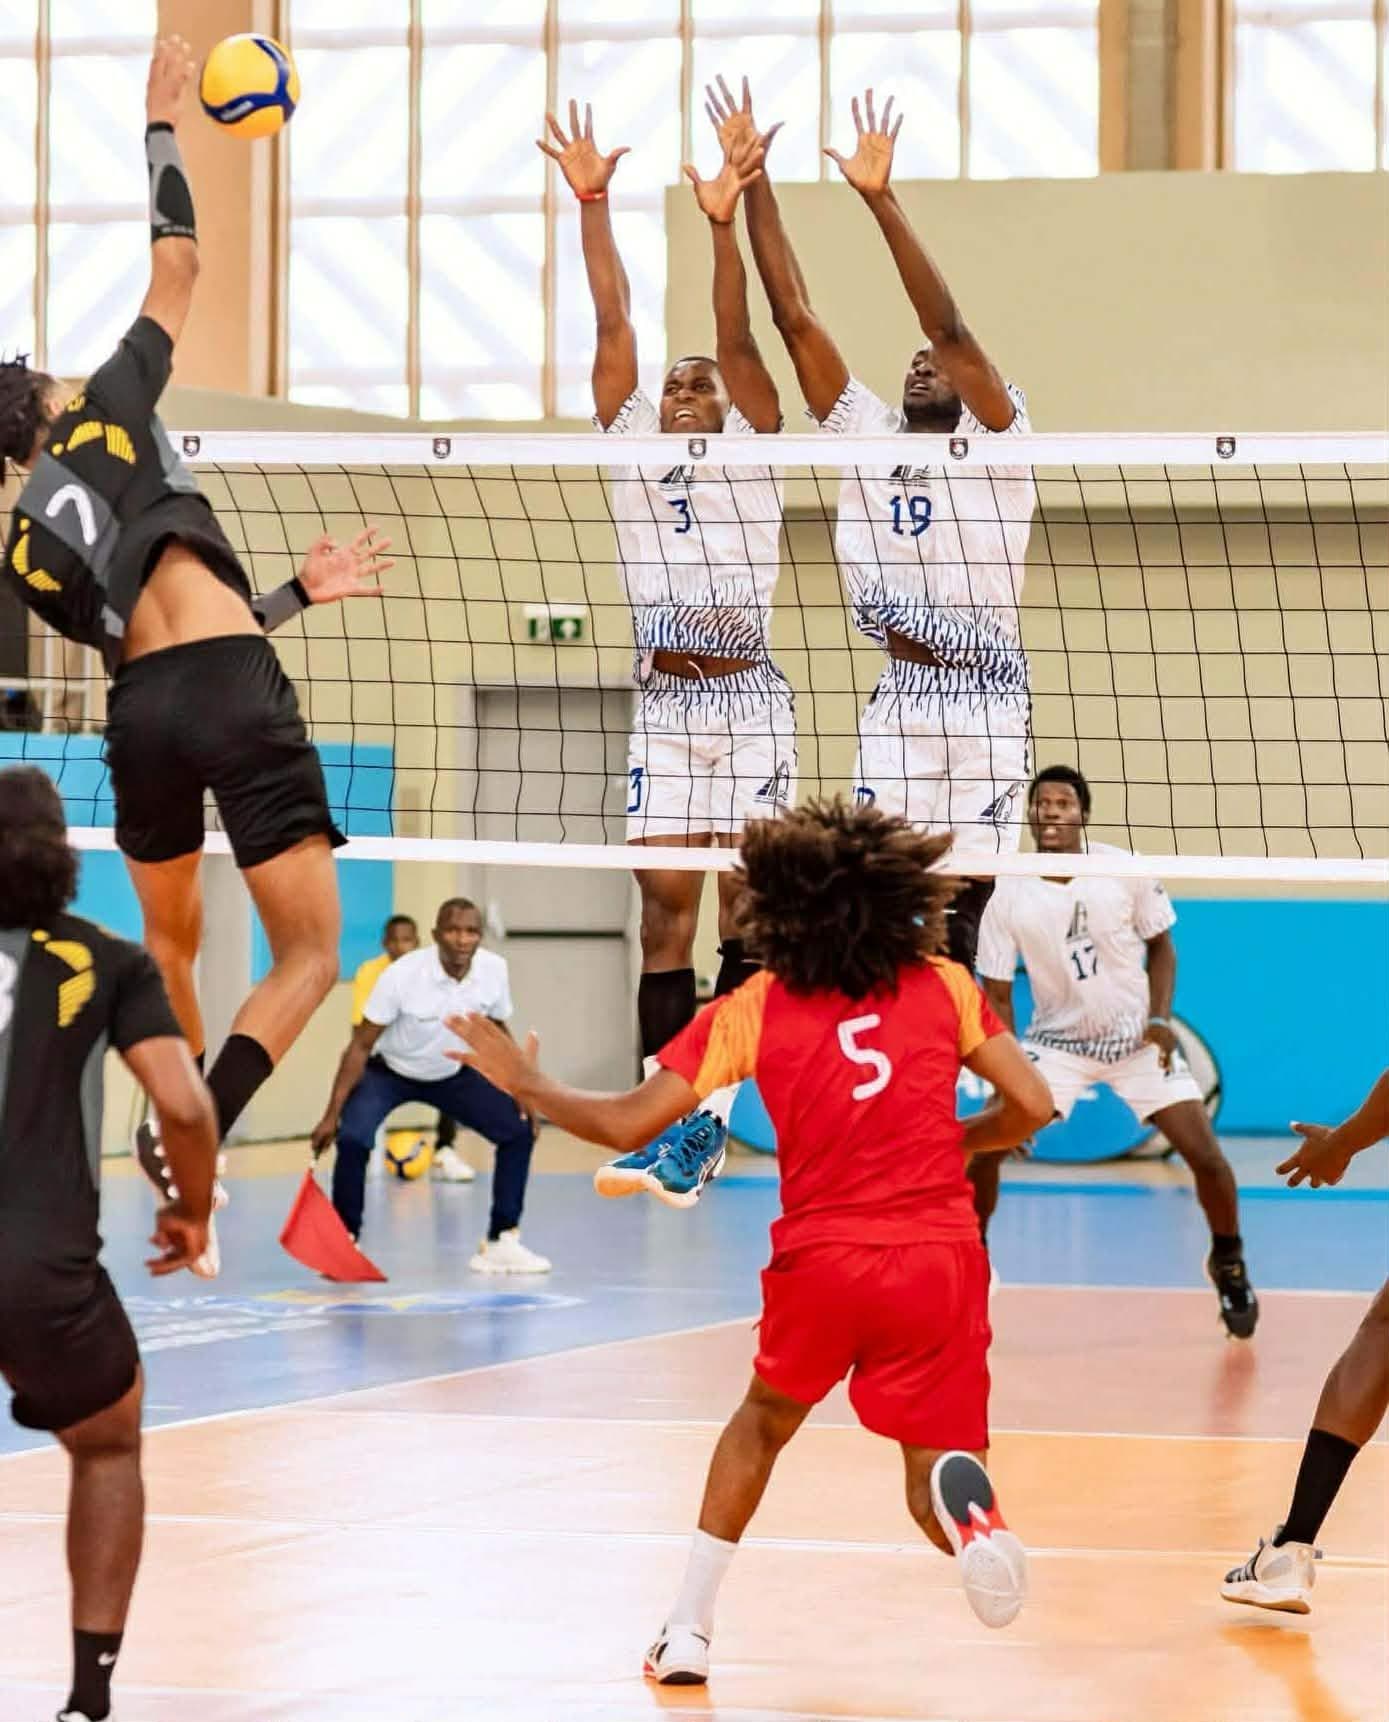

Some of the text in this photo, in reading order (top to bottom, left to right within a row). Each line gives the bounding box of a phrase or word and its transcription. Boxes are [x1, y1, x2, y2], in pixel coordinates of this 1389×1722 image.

[44, 483, 98, 546] 7
[667, 499, 691, 533] 3
[889, 495, 932, 536] 19
[1071, 944, 1097, 981] 17
[837, 1013, 893, 1101] 5
